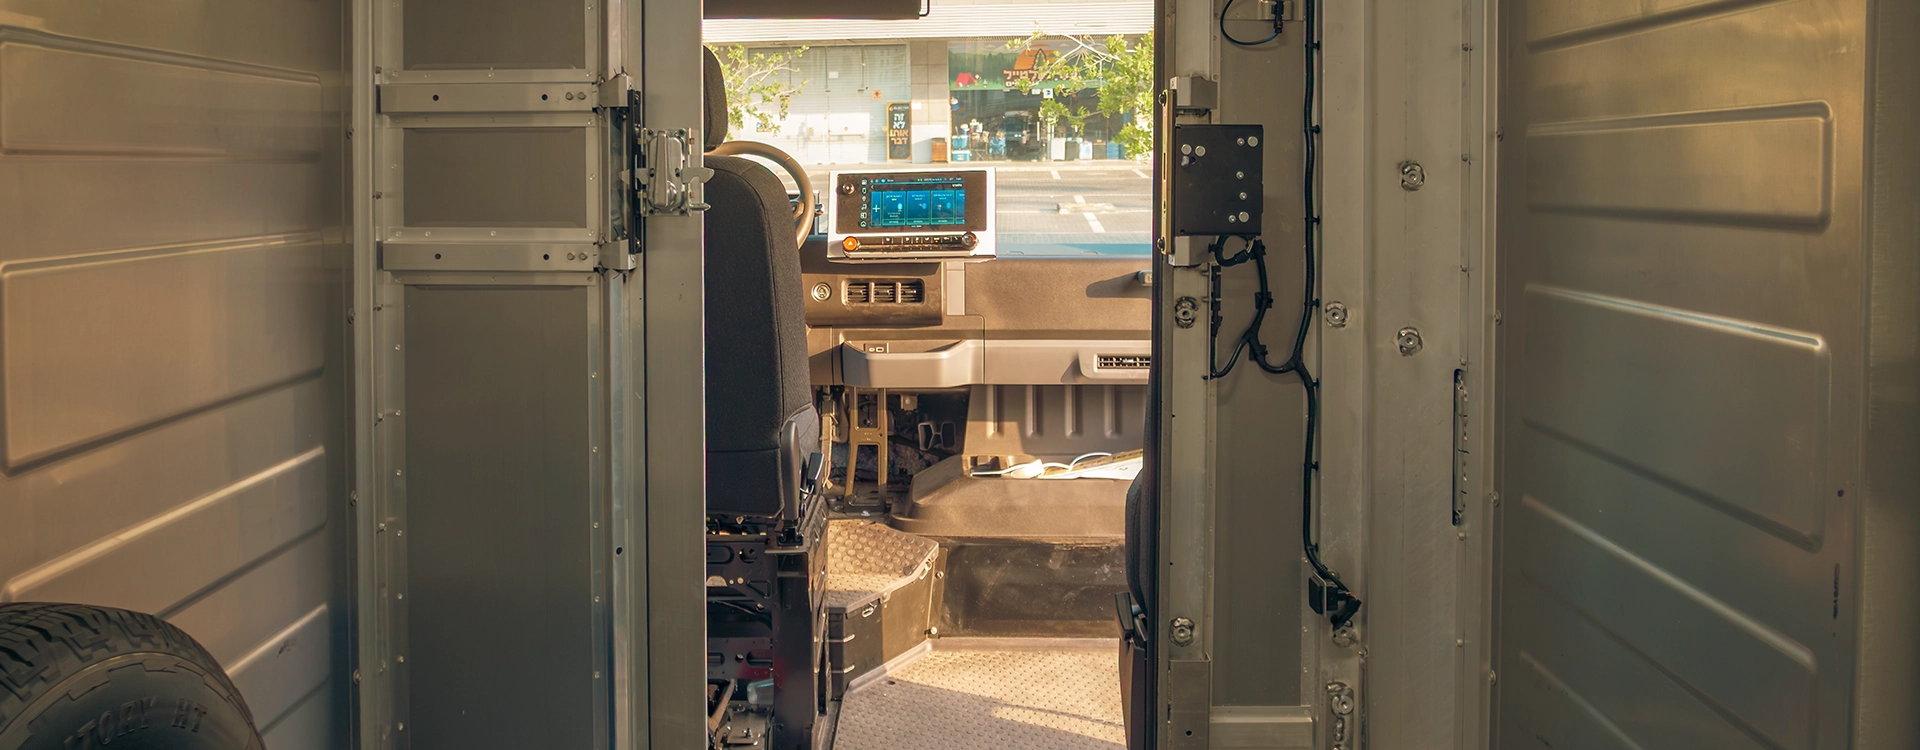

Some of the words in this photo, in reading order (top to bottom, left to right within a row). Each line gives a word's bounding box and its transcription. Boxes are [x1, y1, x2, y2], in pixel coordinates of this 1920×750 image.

[894, 113, 904, 121] זה
[893, 120, 906, 129] לא
[891, 137, 908, 145] דבר
[63, 695, 158, 750] TORY
[171, 697, 208, 733] HT
